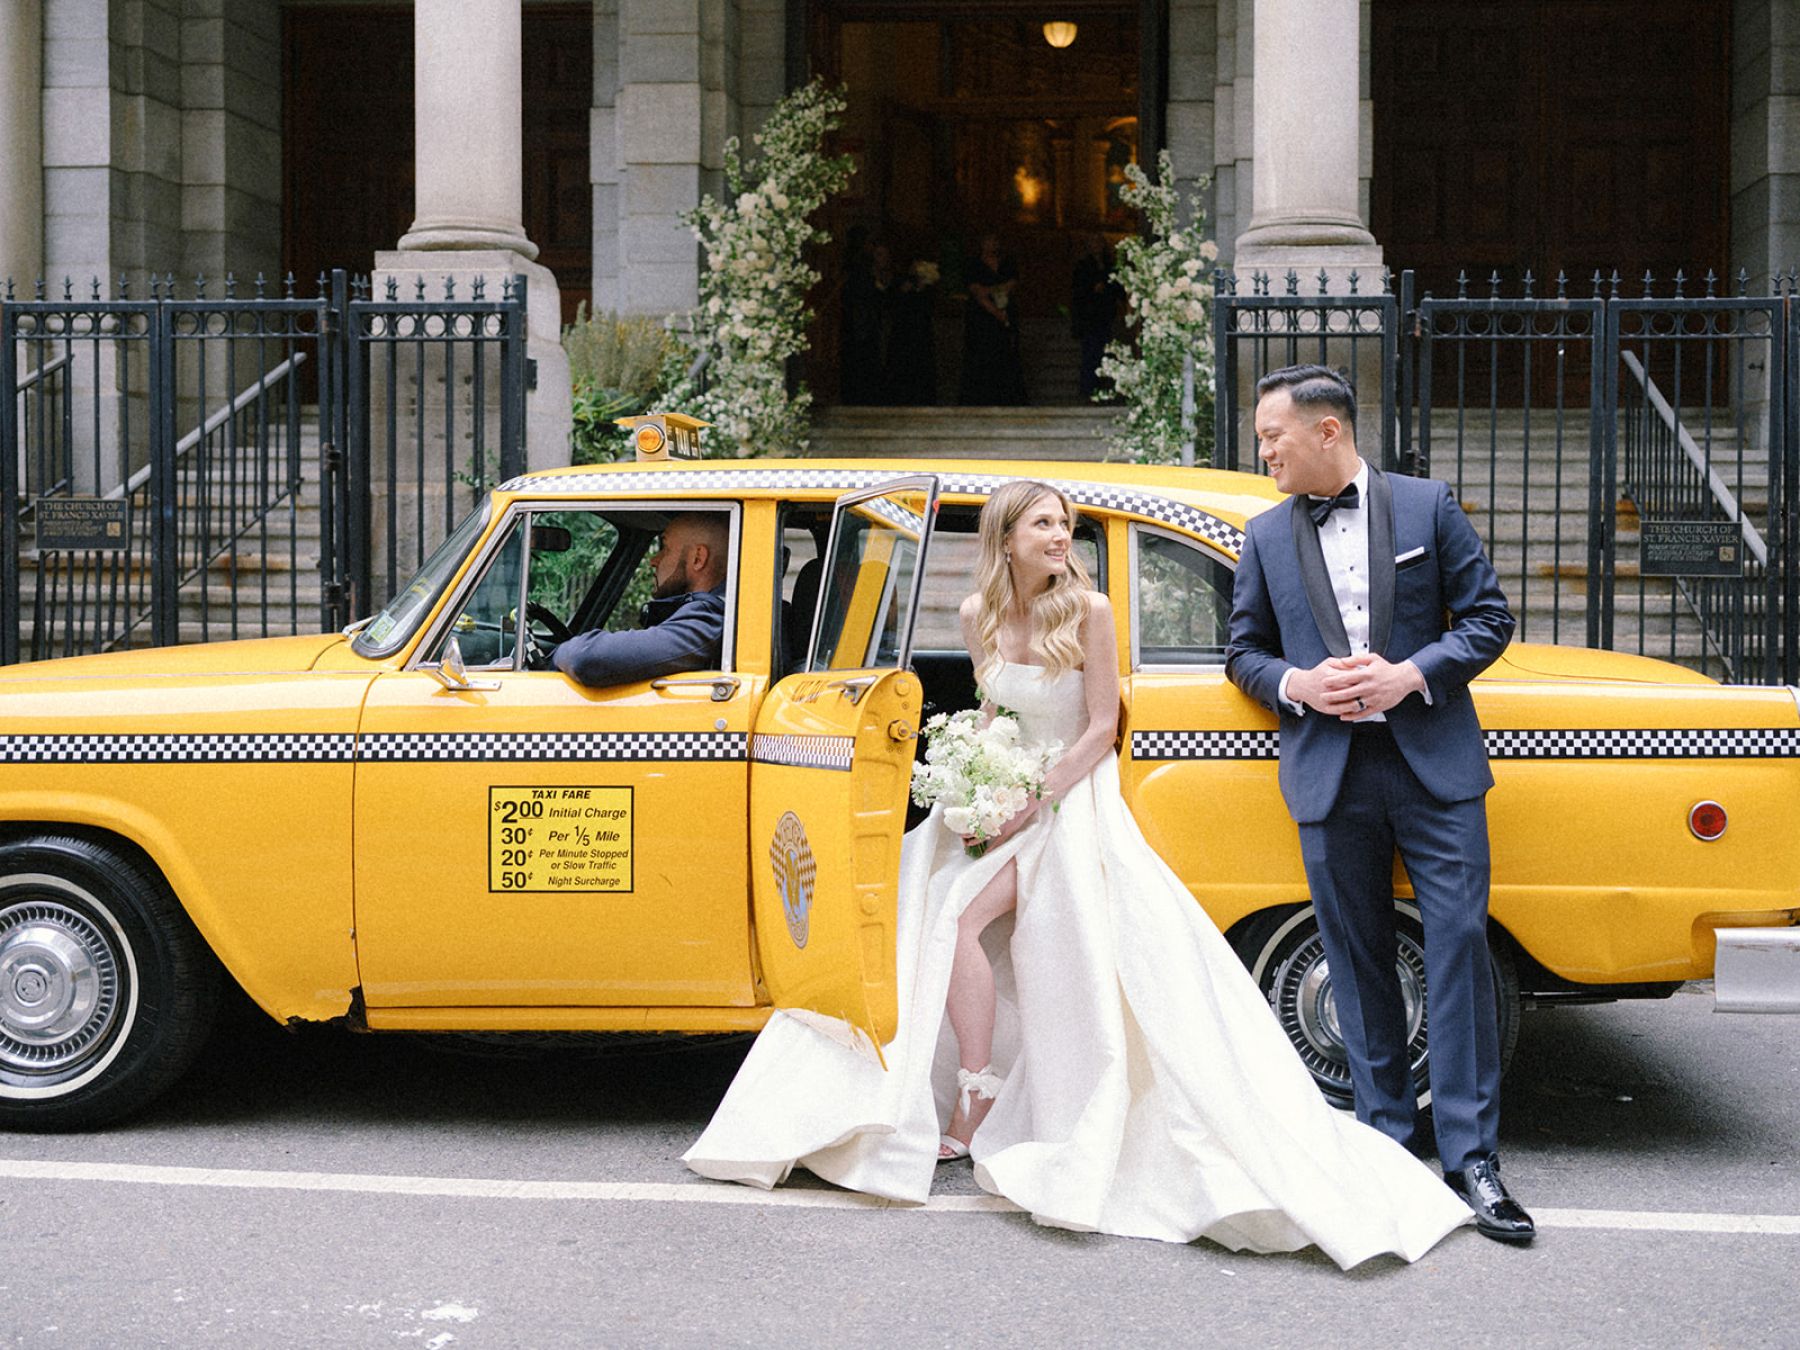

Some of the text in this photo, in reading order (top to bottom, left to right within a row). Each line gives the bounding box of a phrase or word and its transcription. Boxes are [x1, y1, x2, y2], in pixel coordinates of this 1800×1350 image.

[44, 502, 62, 510] THE
[65, 502, 104, 510] CHURCH
[1650, 525, 1734, 533] THE CHURCH OF
[1658, 535, 1700, 543] FRANCIS
[1702, 535, 1739, 543] XAVIER
[531, 790, 592, 800] TAXI FARE
[548, 808, 581, 819] Initial
[584, 808, 627, 821] Charge
[548, 831, 570, 842] Per
[595, 831, 620, 842] Mile
[539, 849, 555, 858] Per
[557, 849, 588, 858] Minute
[590, 849, 629, 860] Stopped
[550, 860, 617, 870] or Slow Traffic
[548, 876, 572, 888] Night
[574, 876, 621, 888] Surcharge
